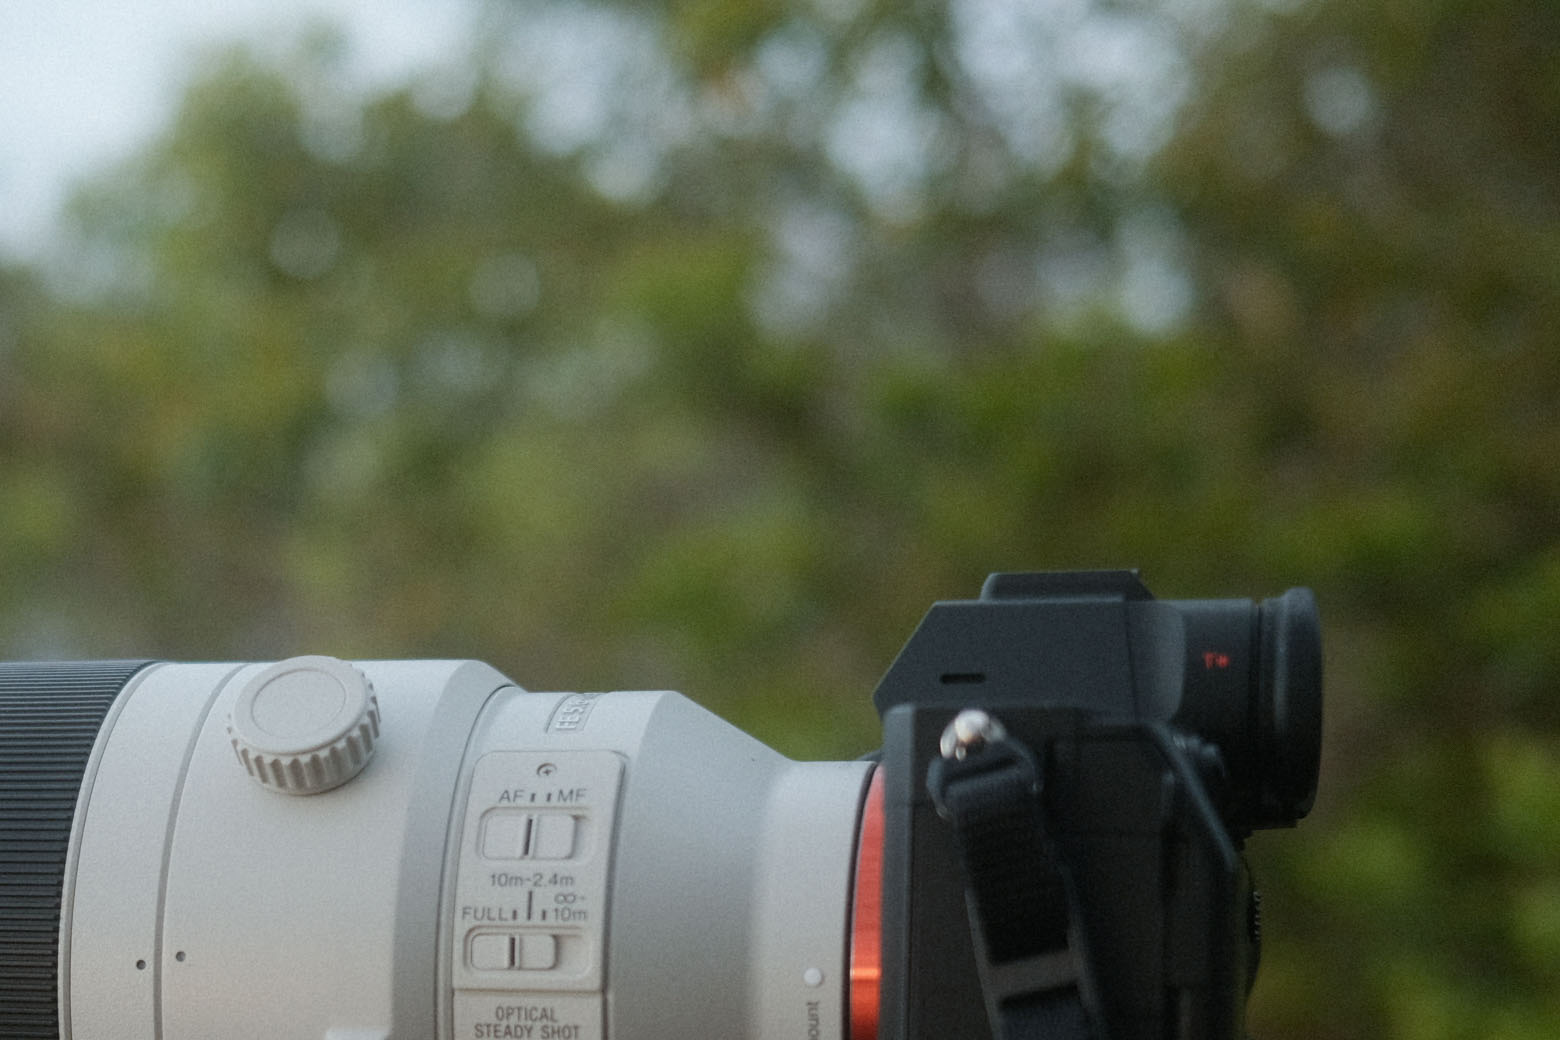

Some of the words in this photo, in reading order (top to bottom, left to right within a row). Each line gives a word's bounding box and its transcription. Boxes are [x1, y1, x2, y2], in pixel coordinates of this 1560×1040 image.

[498, 789, 524, 802] AF
[557, 788, 587, 802] MF
[461, 906, 509, 921] FULL
[553, 906, 588, 921] 10m
[495, 1006, 559, 1022] OPTICAL
[474, 1023, 534, 1039] STEADY
[540, 1025, 581, 1040] SHOT
